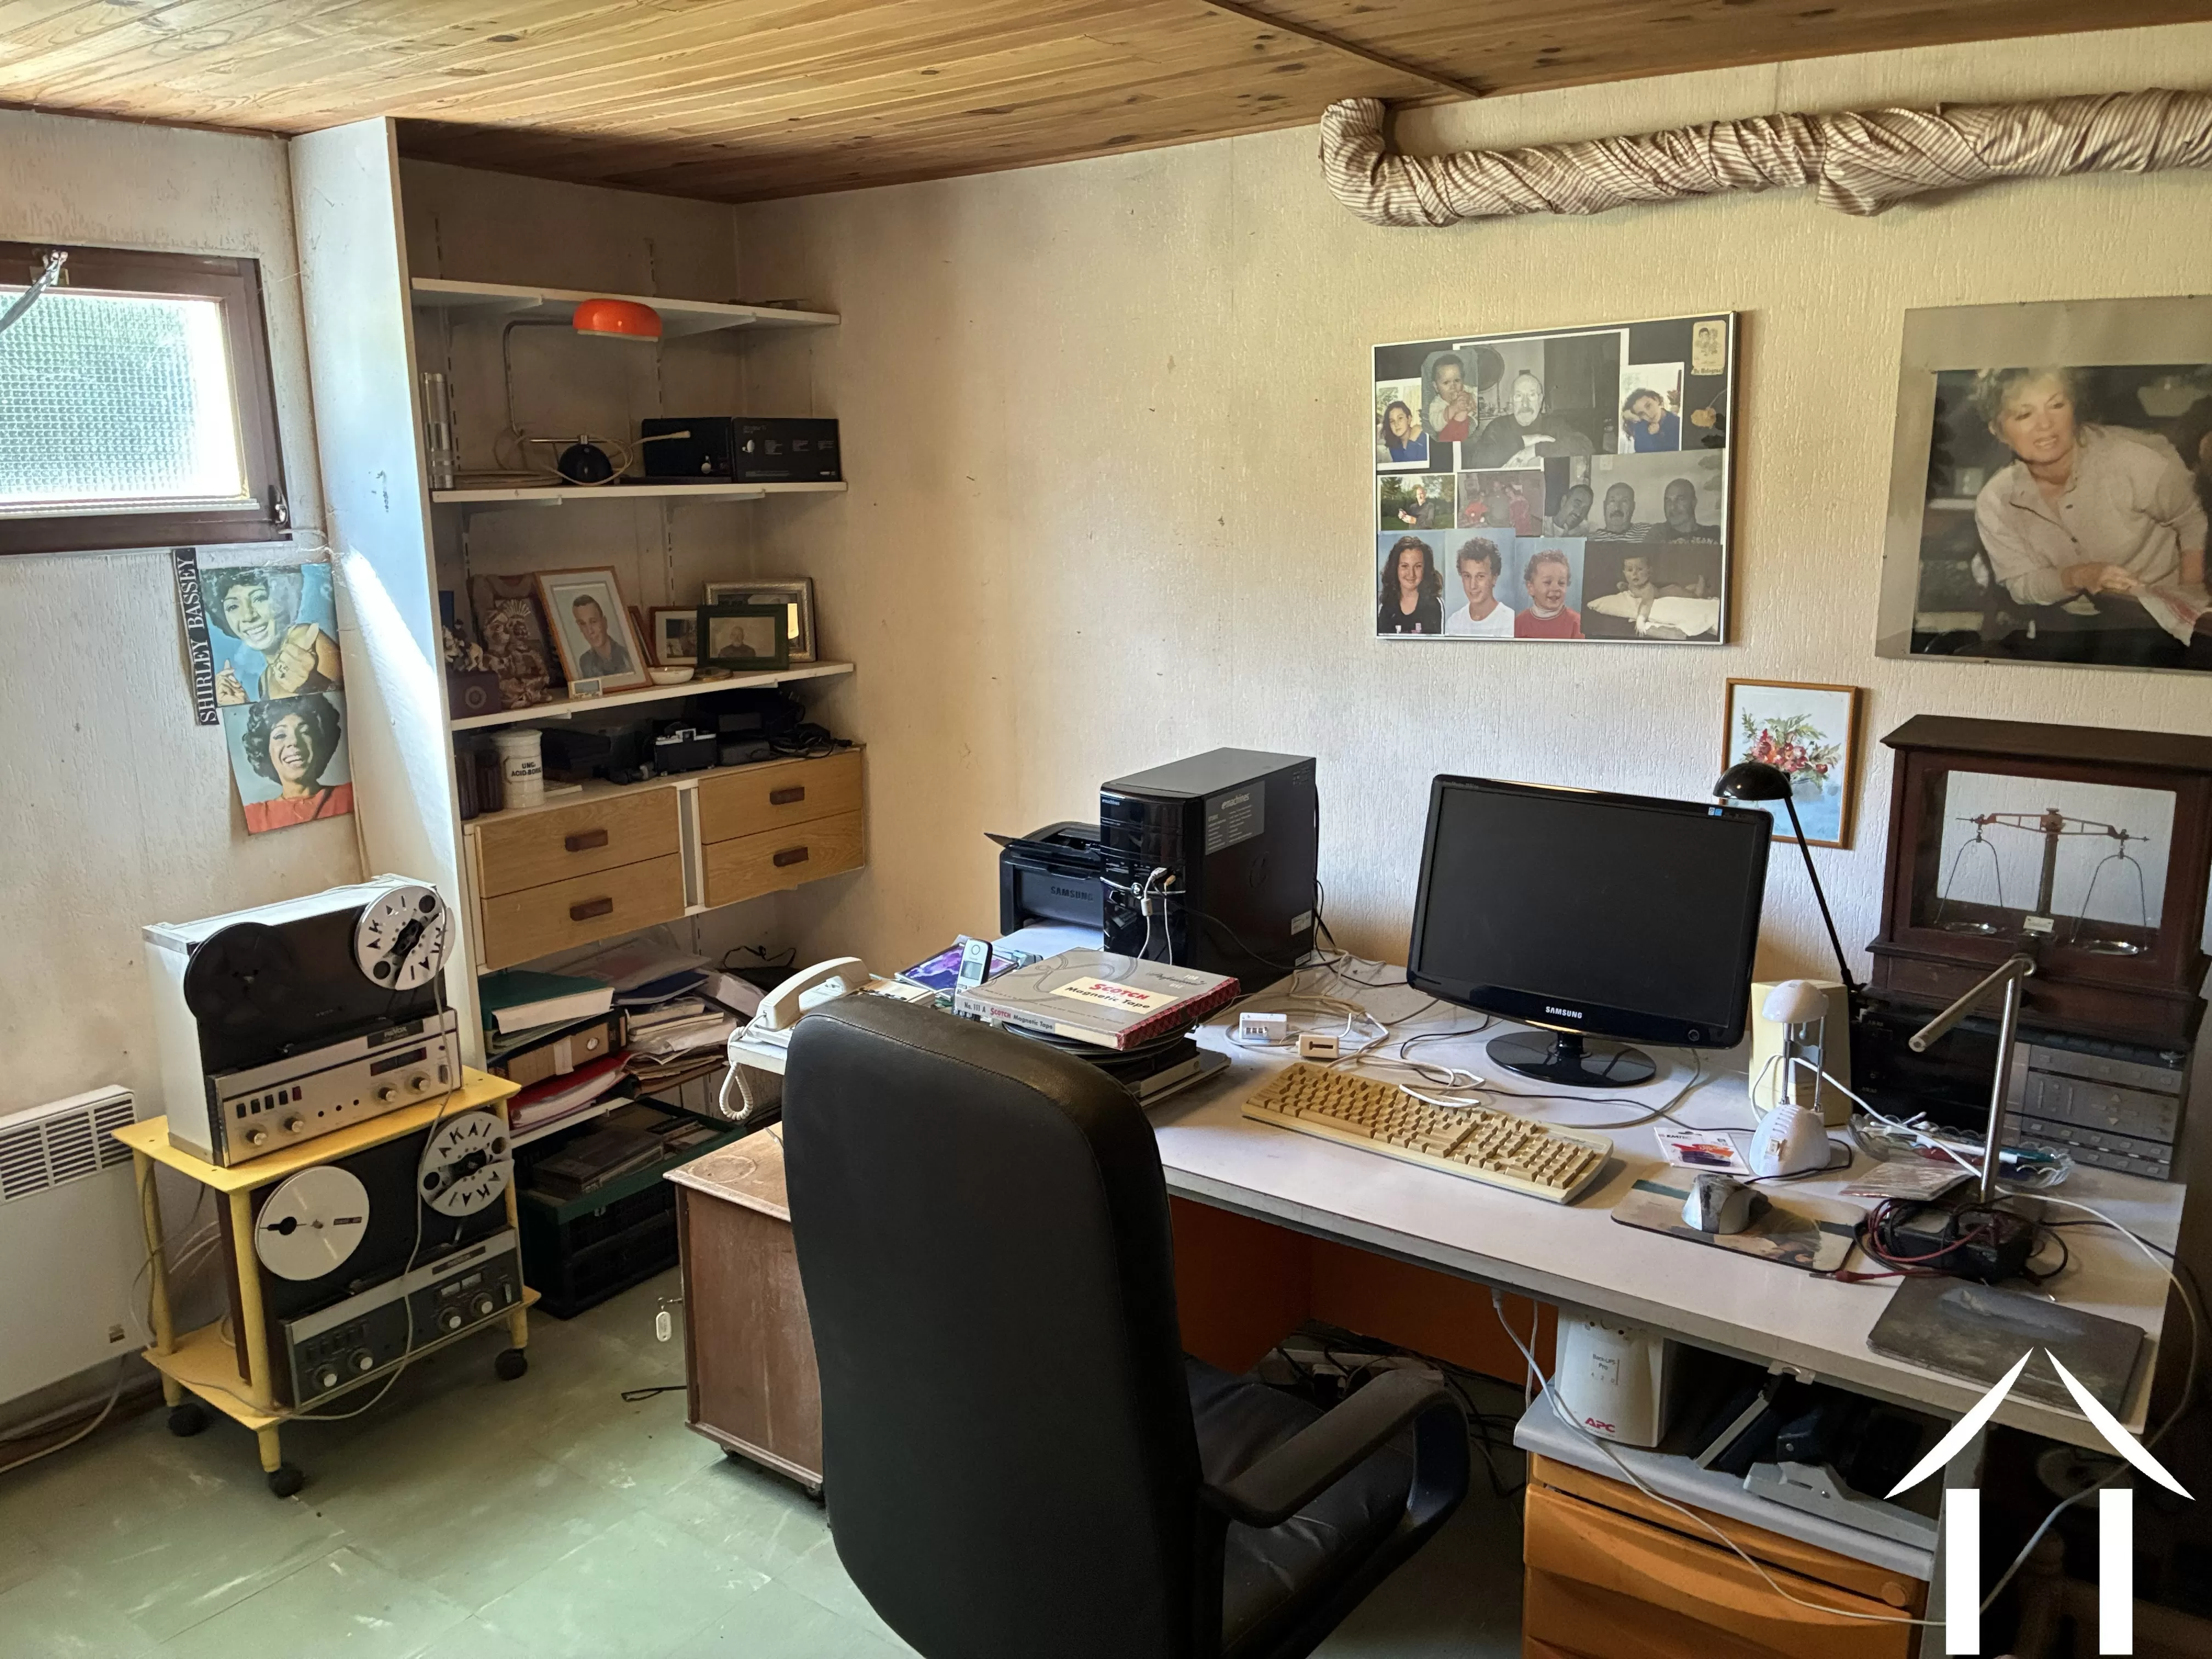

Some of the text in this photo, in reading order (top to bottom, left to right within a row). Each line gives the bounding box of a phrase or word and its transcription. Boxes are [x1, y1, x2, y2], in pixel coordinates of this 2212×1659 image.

[177, 556, 217, 722] SHIRLEY BASSEY
[1051, 886, 1094, 901] SAMSUNG
[1064, 987, 1119, 1002] Magnetic
[1122, 999, 1151, 1009] Tape
[1088, 983, 1150, 1000] SCOTCH
[990, 1007, 1011, 1019] SCOTCH
[1013, 1014, 1038, 1026] Magnetic
[1040, 1021, 1053, 1030] Tape
[1545, 1006, 1583, 1019] SAMSUNG
[438, 1122, 492, 1159] AKAI
[448, 1170, 501, 1207] AKAI
[1584, 1418, 1616, 1433] APC
